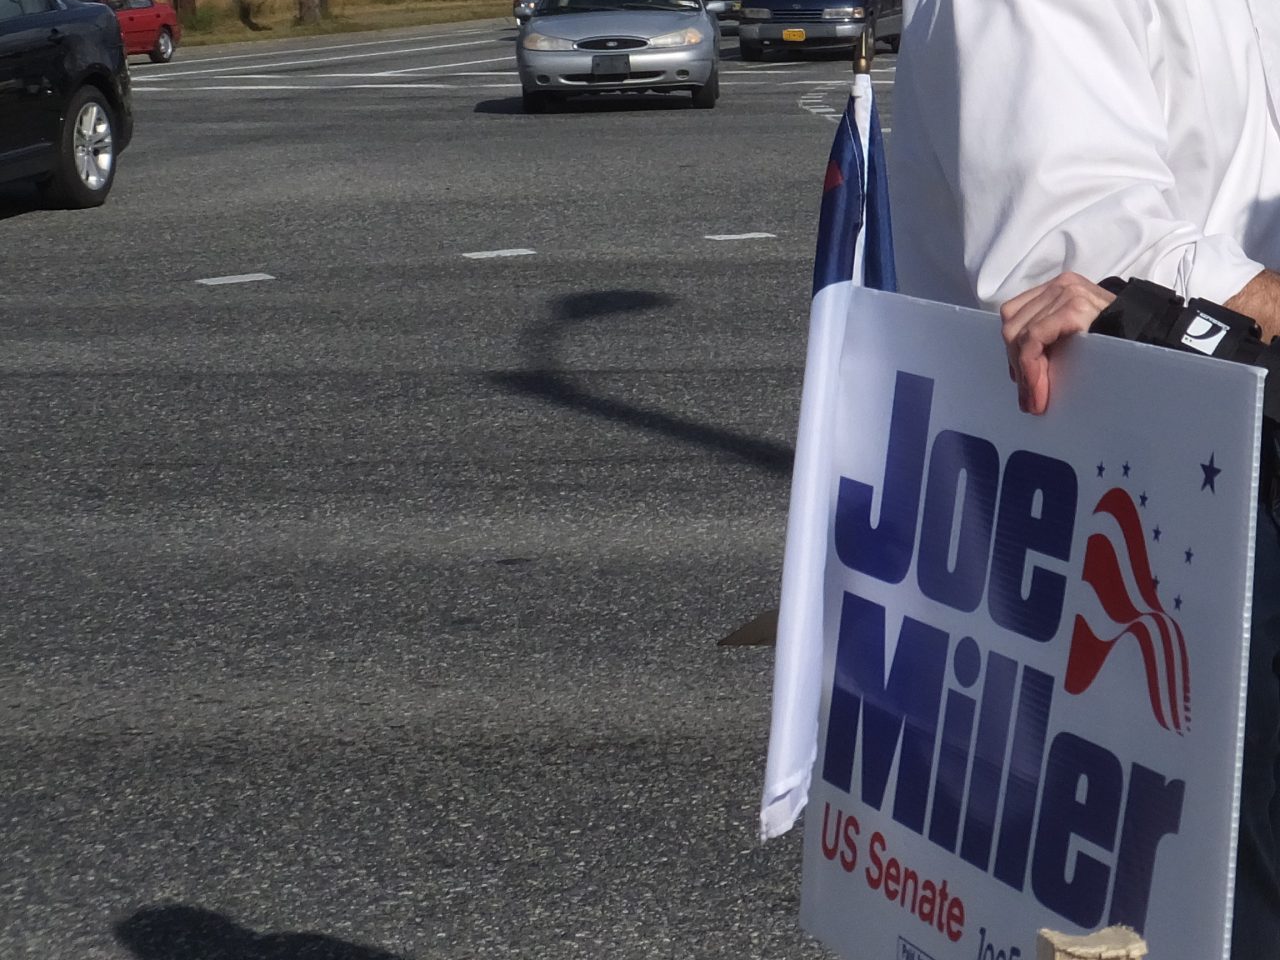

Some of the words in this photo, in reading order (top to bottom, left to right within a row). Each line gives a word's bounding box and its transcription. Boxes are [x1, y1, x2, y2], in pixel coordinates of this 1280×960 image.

[835, 370, 1078, 643] Joe
[822, 590, 1185, 936] Miller
[822, 802, 860, 872] US
[866, 831, 965, 942] Senate
